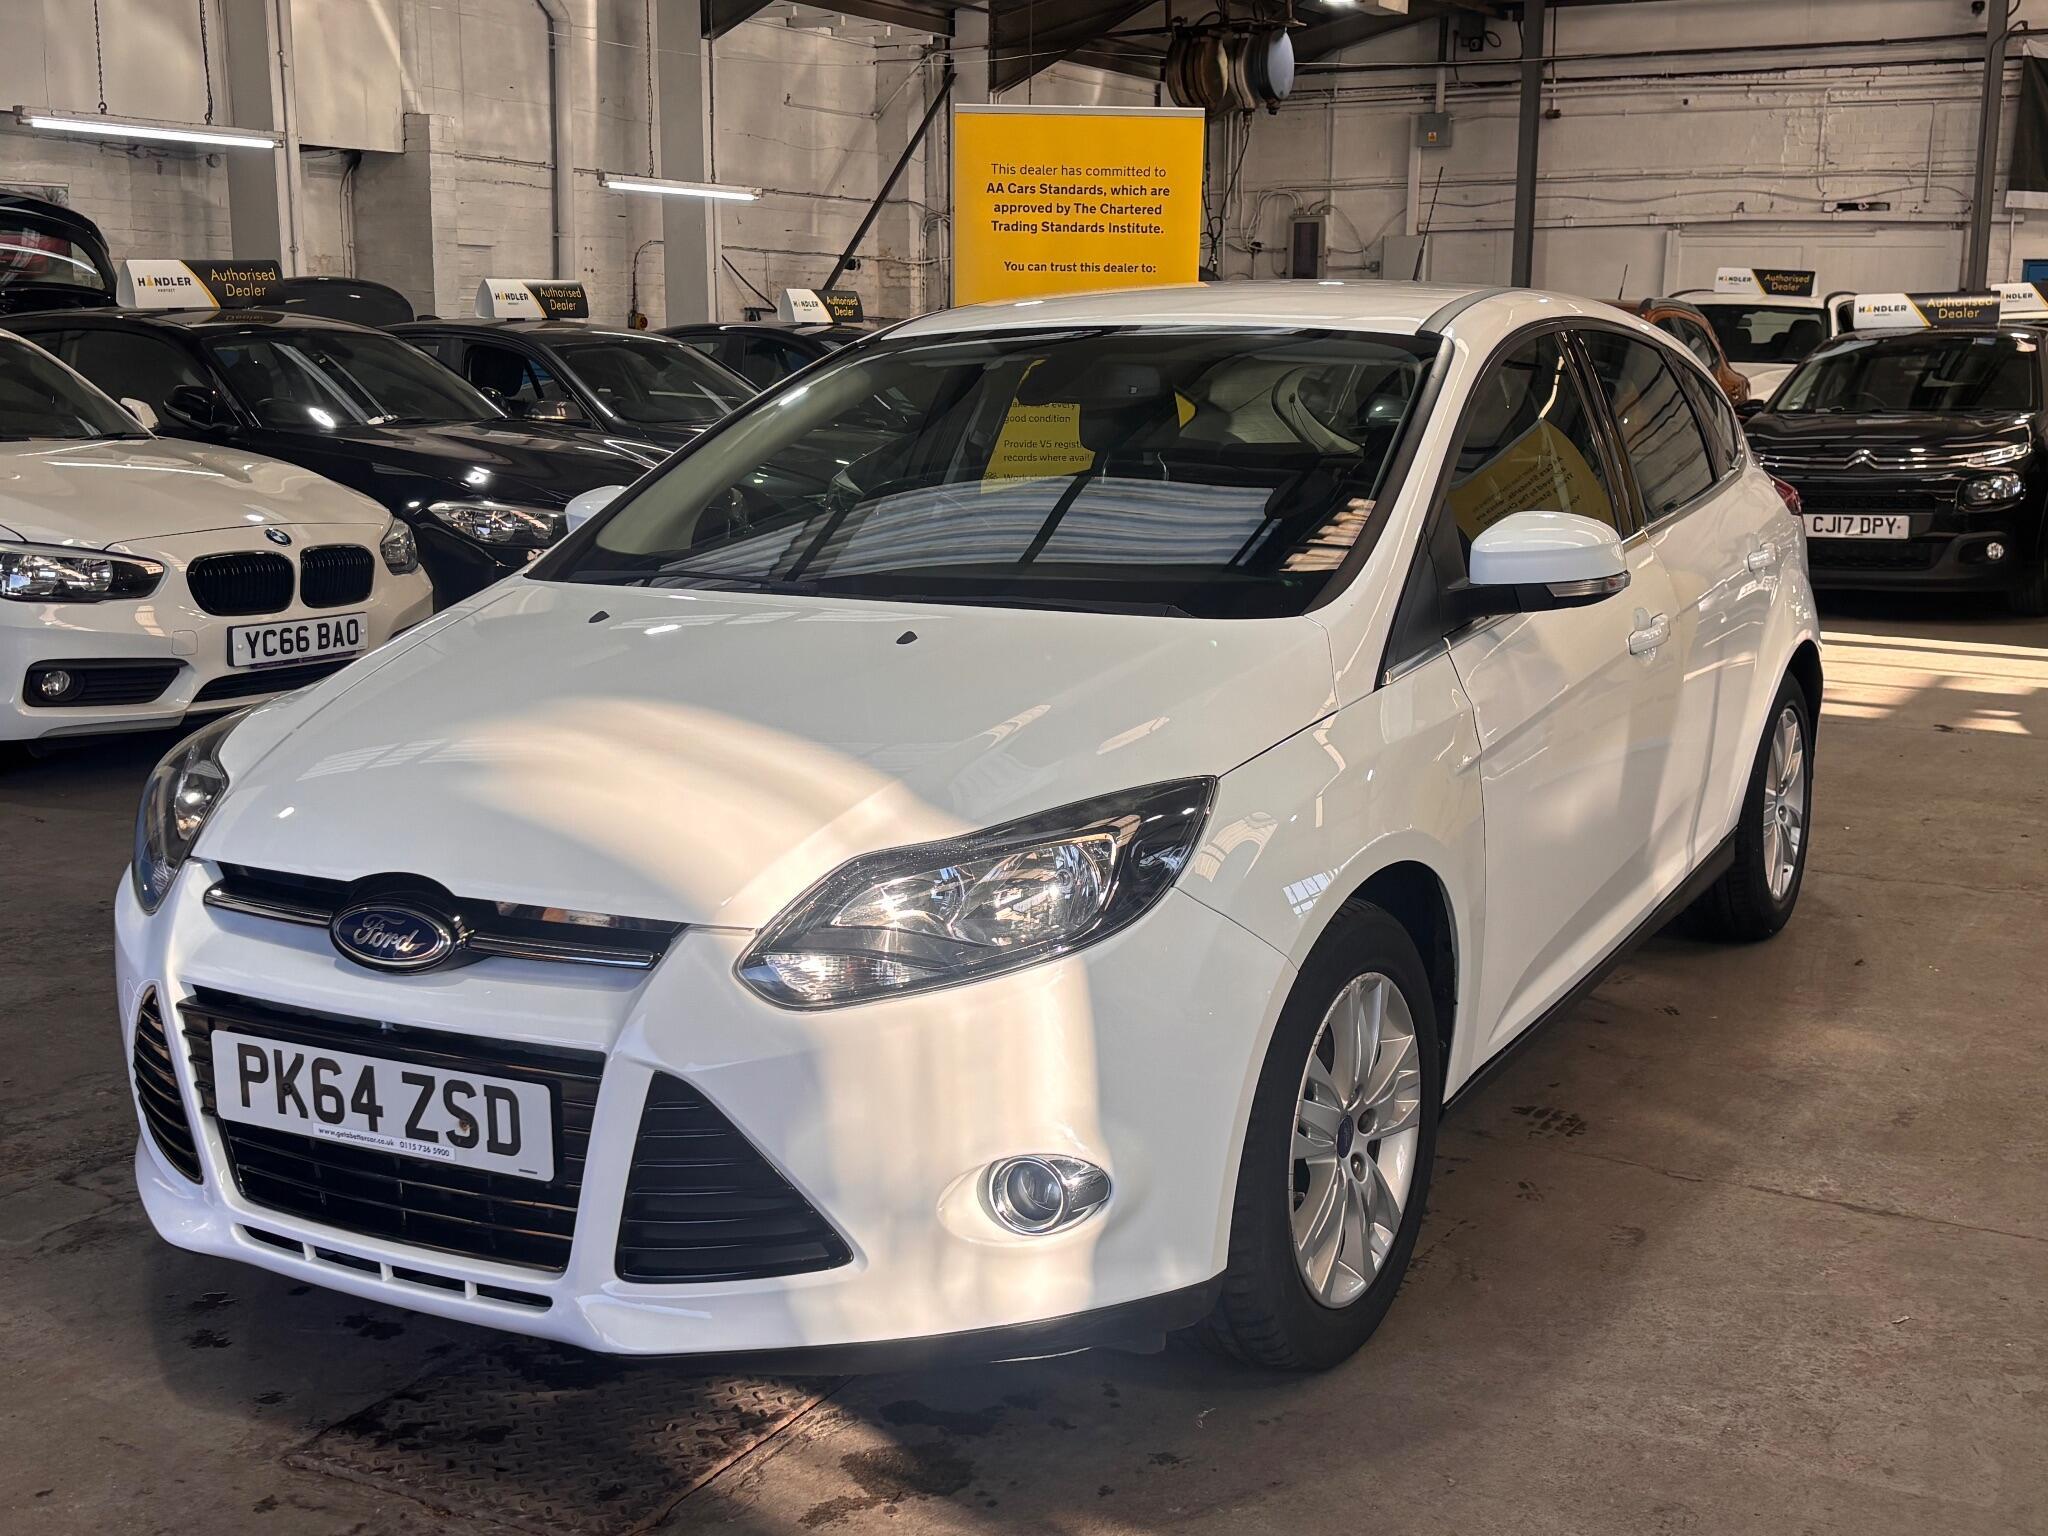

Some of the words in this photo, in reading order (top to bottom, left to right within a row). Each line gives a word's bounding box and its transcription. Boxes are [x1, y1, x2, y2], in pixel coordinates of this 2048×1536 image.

[991, 163, 1016, 175] This
[1020, 164, 1057, 176] dealer
[1061, 165, 1082, 176] has
[1085, 165, 1151, 177] committed
[1154, 166, 1166, 177] to
[986, 182, 1004, 194] AA
[1007, 183, 1036, 194] Cars
[1039, 183, 1107, 197] Standards,
[1110, 185, 1147, 196] which
[1150, 187, 1170, 196] are
[993, 203, 1053, 215] approved
[1056, 203, 1071, 215] by
[1074, 203, 1097, 214] The
[1100, 203, 1162, 215] Chartered
[991, 220, 1038, 234] Trading
[1041, 221, 1105, 233] Standards
[1108, 222, 1165, 234] Institute.
[1004, 261, 1025, 272] You
[1027, 262, 1047, 272] can
[1050, 262, 1077, 273] trust
[1080, 262, 1100, 273] this
[1103, 262, 1138, 273] dealer
[1141, 263, 1157, 273] to:
[137, 274, 192, 287] HANDLER
[211, 267, 276, 282] Authorised
[1764, 273, 1810, 284] Authorised
[225, 283, 266, 297] Dealer
[540, 286, 582, 298] Authorised
[1771, 282, 1800, 291] Dealer
[550, 300, 577, 311] Dealer
[1926, 295, 1993, 309] Authorised
[1938, 308, 1980, 320] Dealer
[1029, 413, 1071, 423] condition
[1004, 439, 1038, 448] Provide
[1054, 439, 1080, 449] regist
[1003, 453, 1037, 462] records
[1040, 454, 1066, 462] where
[1812, 516, 1854, 534] CJ17
[1860, 517, 1897, 534] DPY
[245, 625, 310, 659] YC66
[317, 618, 359, 650] BAO
[353, 913, 424, 952] Ford
[237, 1042, 384, 1132] PK64
[401, 1071, 521, 1157] ZSD
[399, 1141, 417, 1151] 0115
